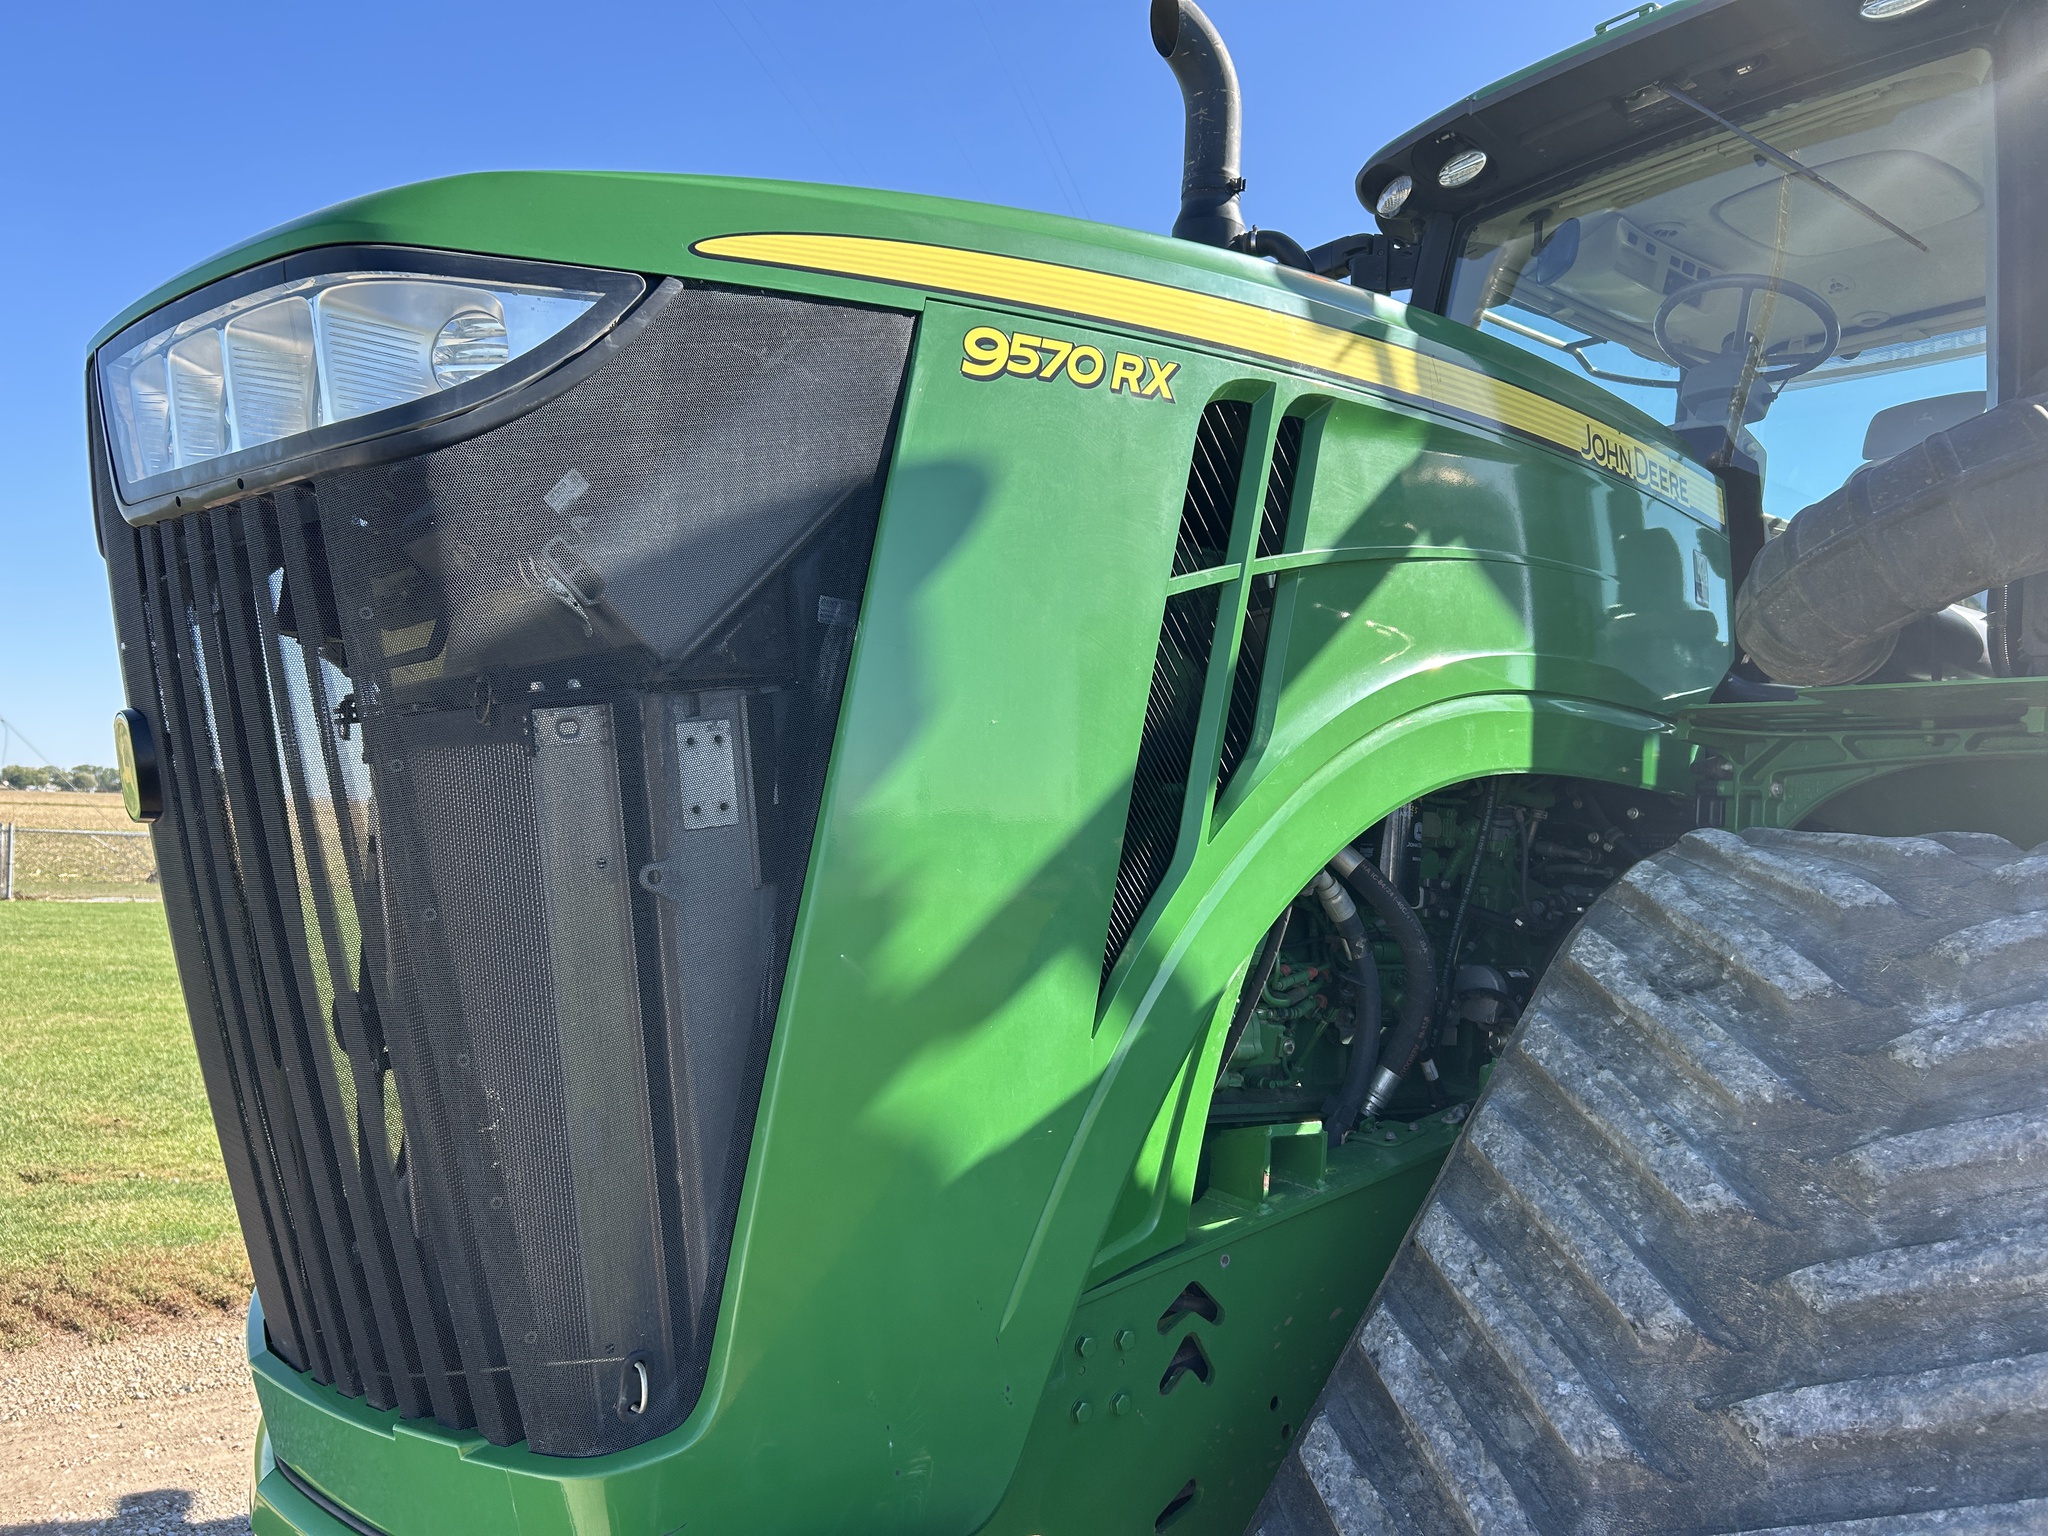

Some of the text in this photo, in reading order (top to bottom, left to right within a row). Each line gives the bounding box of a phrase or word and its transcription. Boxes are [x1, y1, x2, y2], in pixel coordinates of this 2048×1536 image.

[960, 326, 1181, 404] 9570 RX
[1581, 424, 1690, 506] JOHN DEERE
[1482, 815, 1490, 831] Made
[1487, 795, 1495, 809] USA
